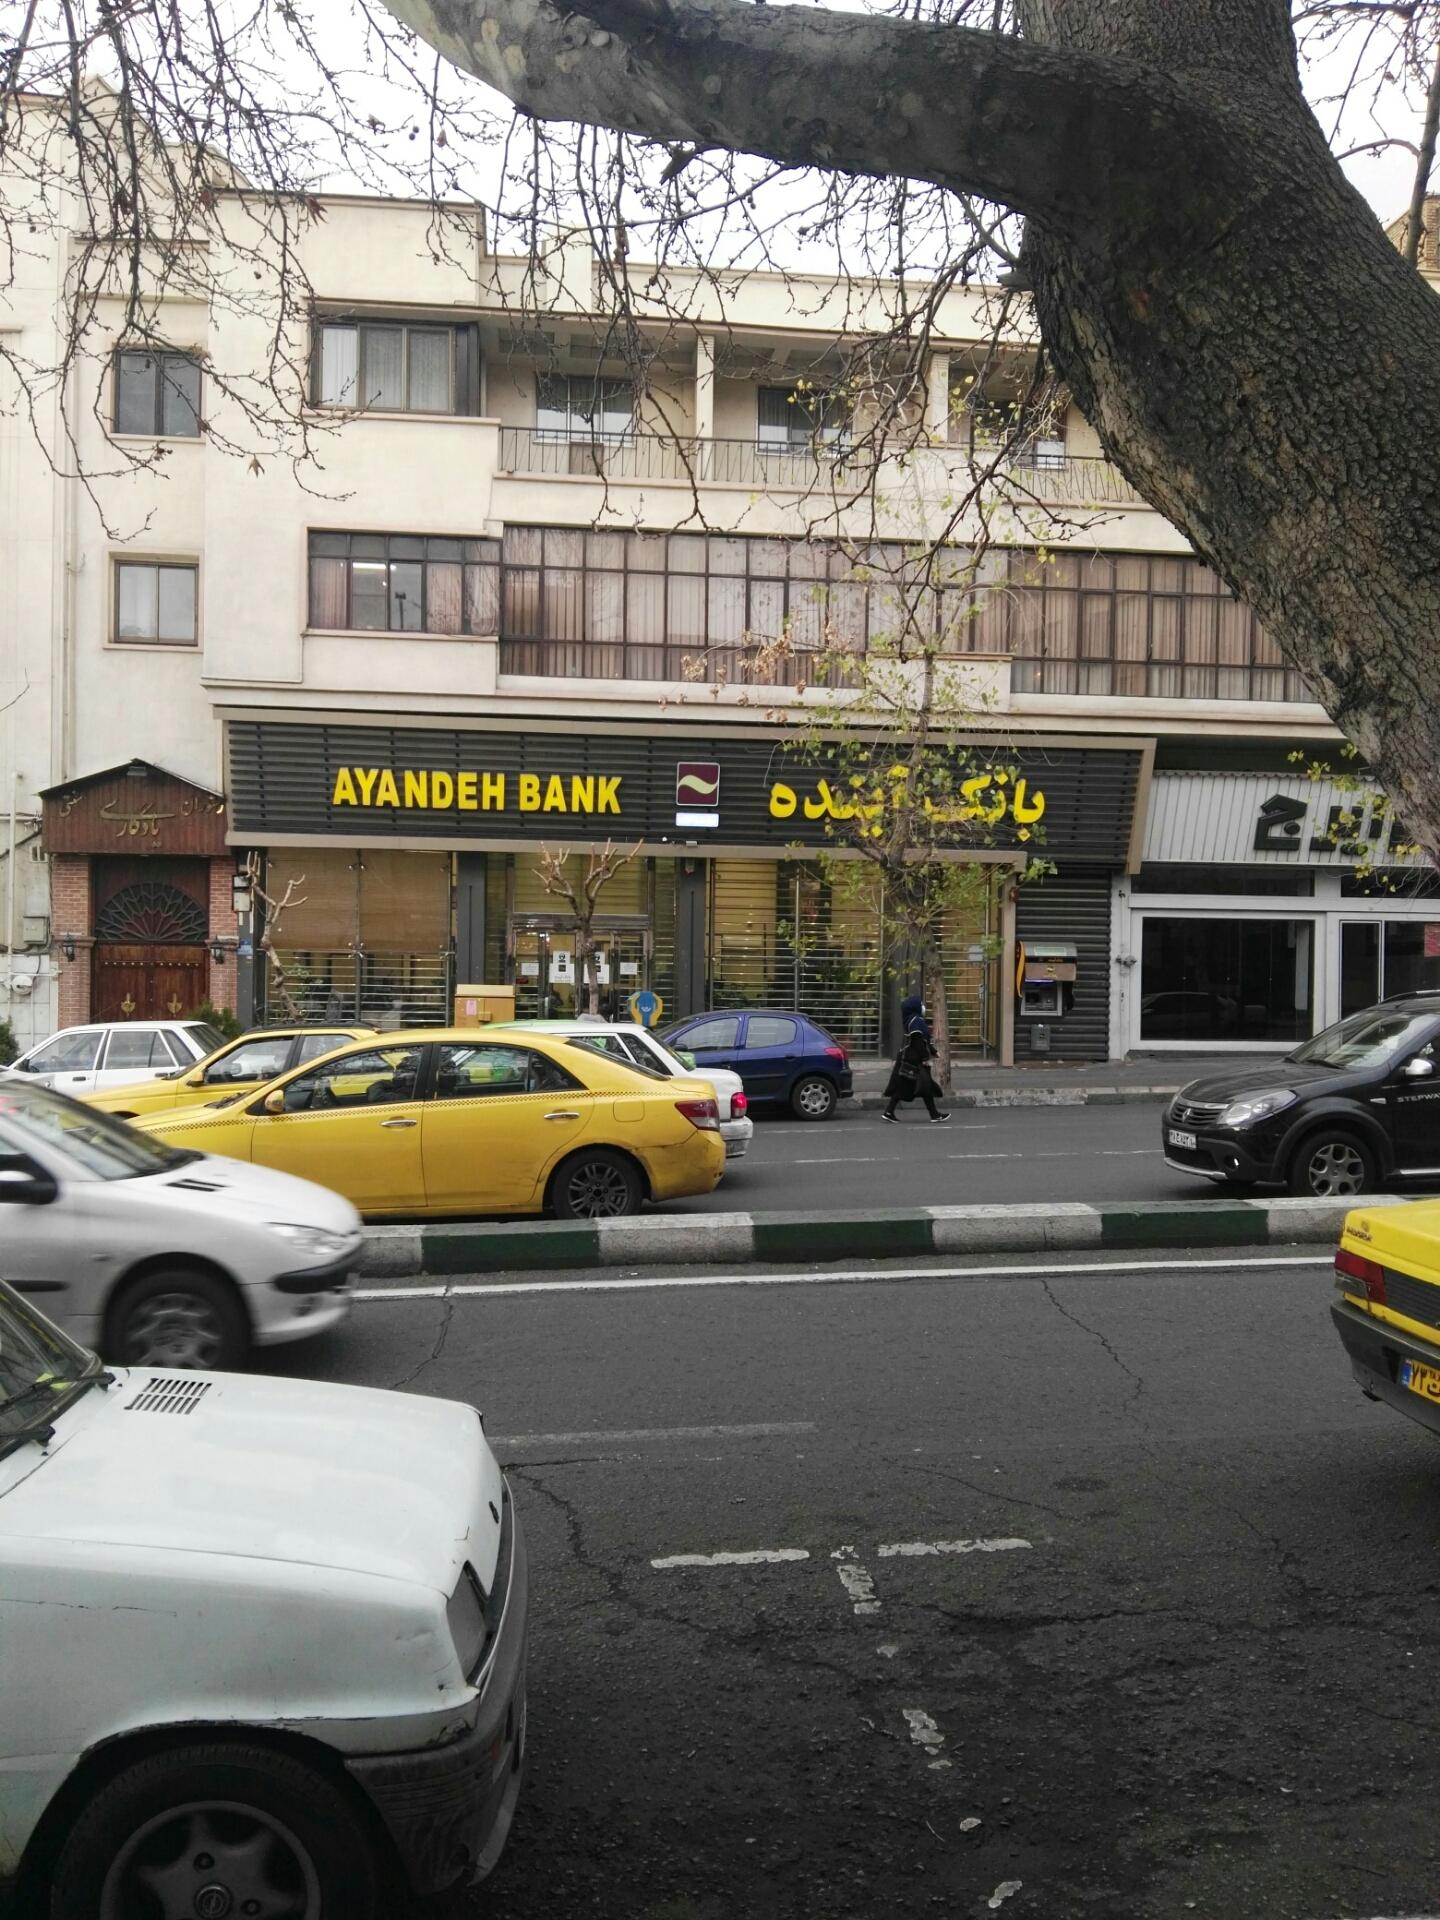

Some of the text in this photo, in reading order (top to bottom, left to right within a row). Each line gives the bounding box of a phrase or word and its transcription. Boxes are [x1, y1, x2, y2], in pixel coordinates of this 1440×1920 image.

[332, 766, 623, 815] AYANDEH BANK
[924, 772, 1046, 842] بانک
